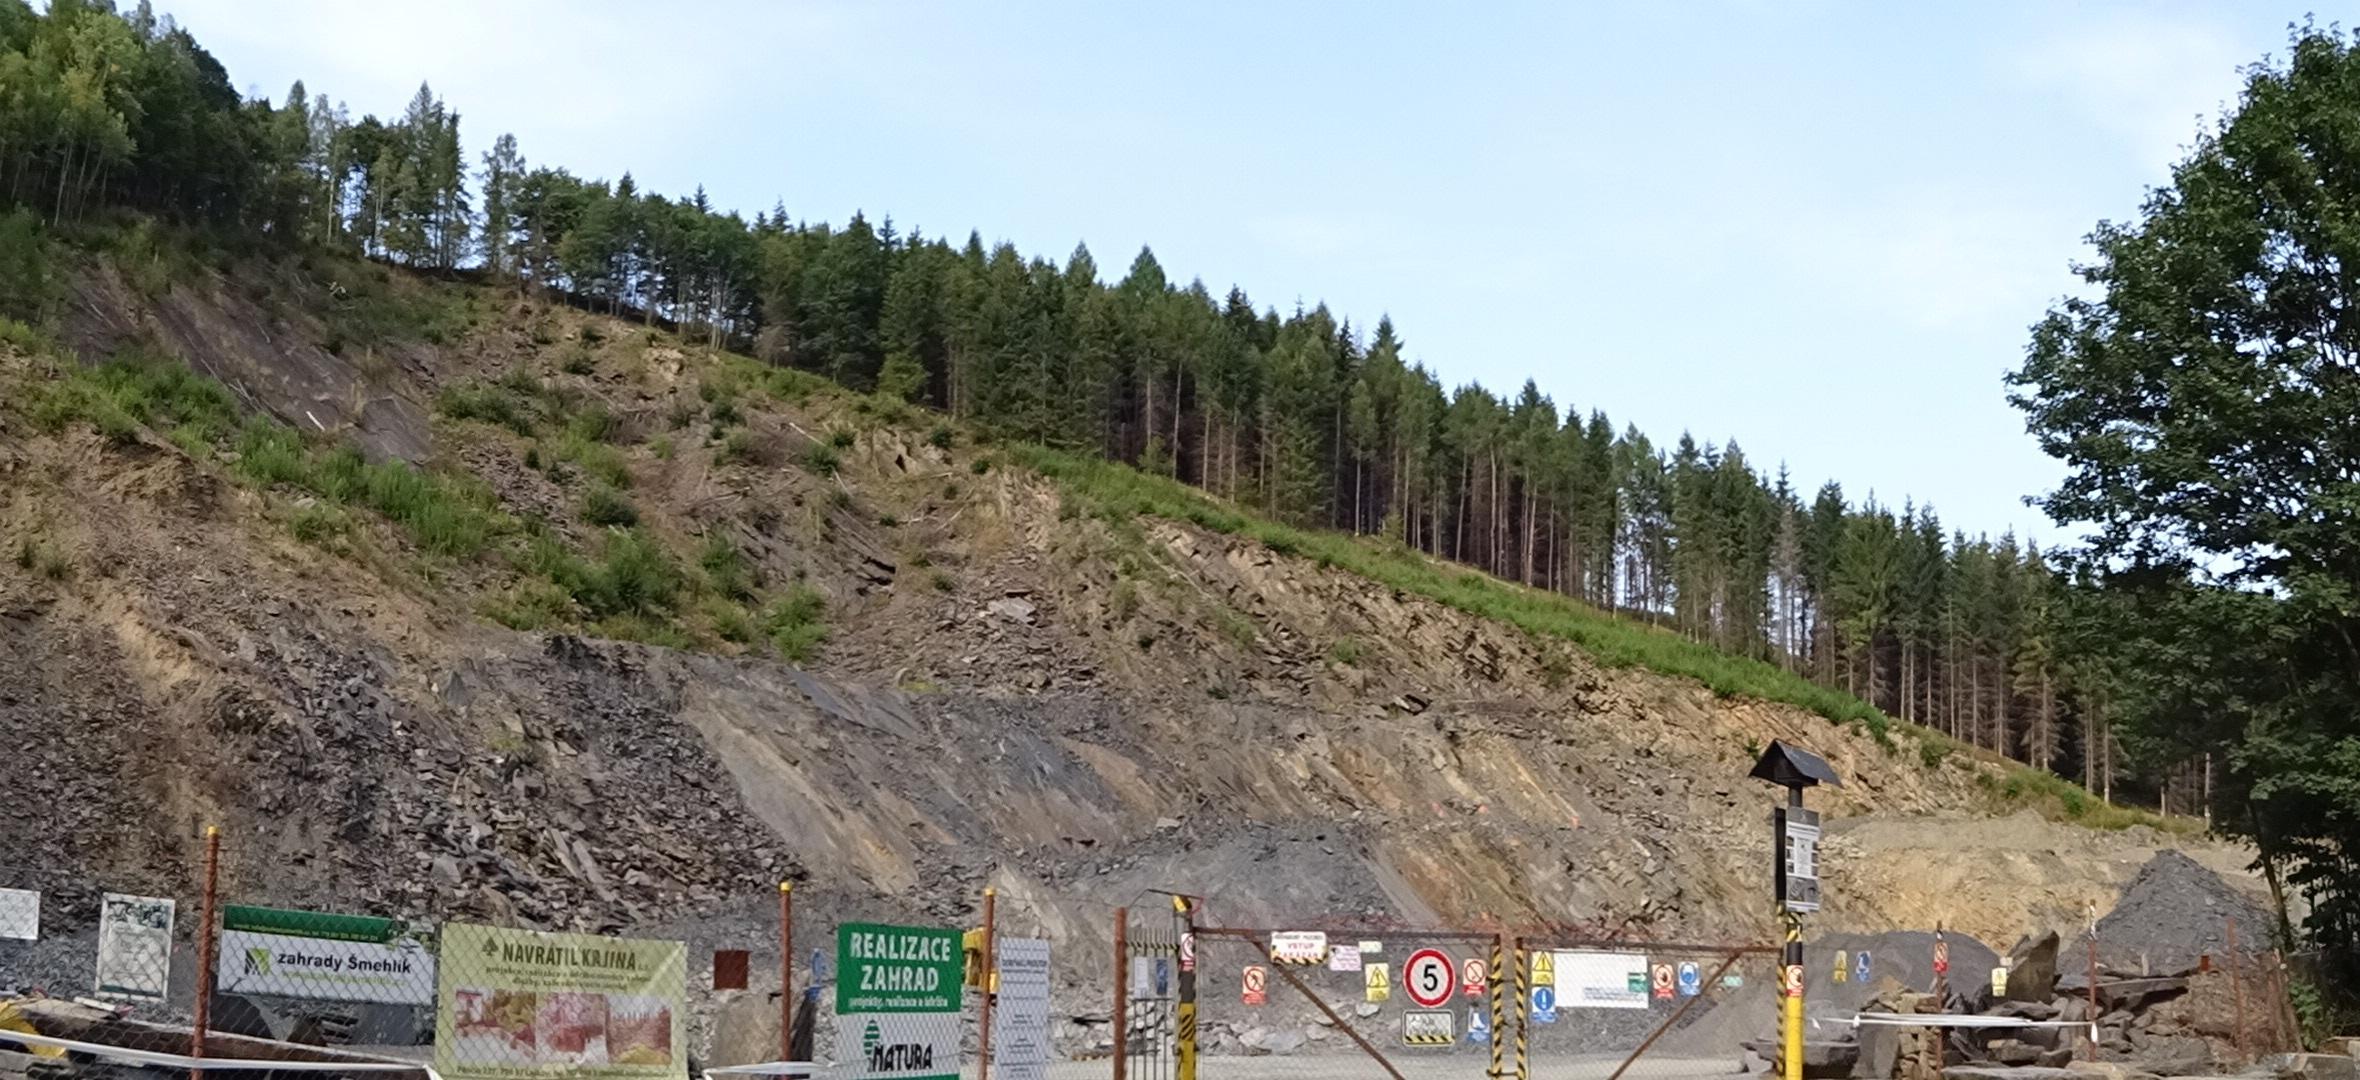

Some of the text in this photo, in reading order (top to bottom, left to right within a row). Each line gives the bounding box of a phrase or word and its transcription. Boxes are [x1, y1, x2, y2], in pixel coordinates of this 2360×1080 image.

[850, 932, 951, 962] REALIZACE
[277, 951, 411, 974] zahrady Šmehlík
[861, 965, 938, 992] ZAHRAD
[1423, 964, 1438, 992] 5
[873, 1043, 932, 1073] NATURA
